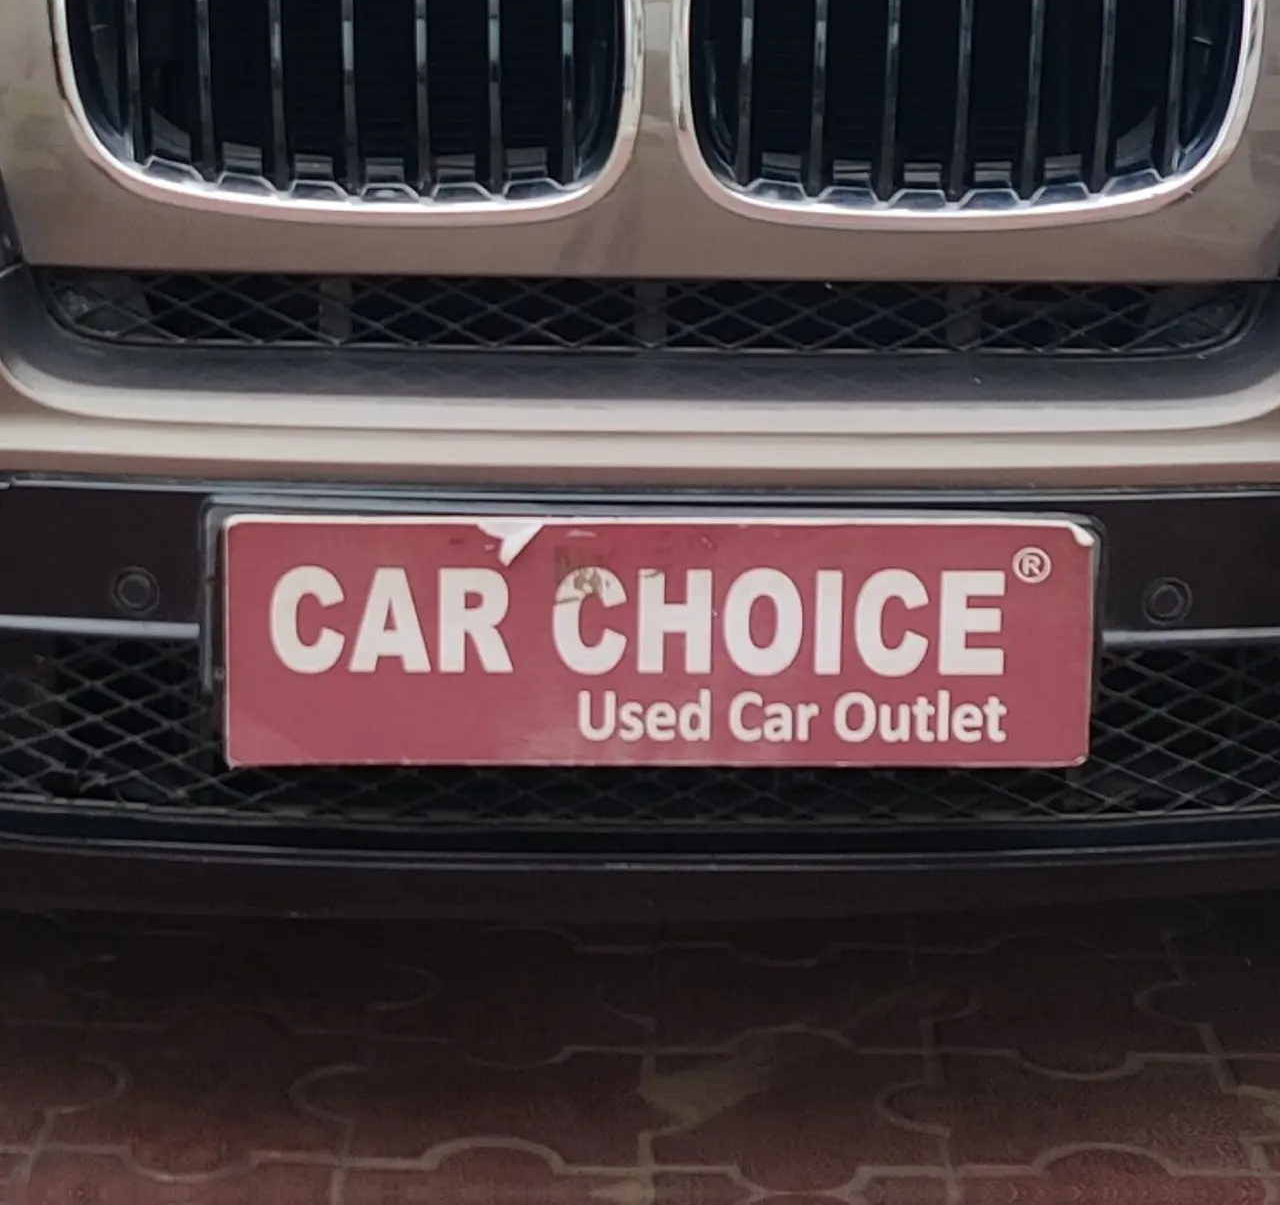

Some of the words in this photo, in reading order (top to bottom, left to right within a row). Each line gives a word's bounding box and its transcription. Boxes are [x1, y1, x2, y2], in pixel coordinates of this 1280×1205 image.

[269, 565, 515, 674] CAR
[578, 691, 711, 743] Used
[728, 691, 820, 744] Car
[833, 690, 1007, 744] Outlet
